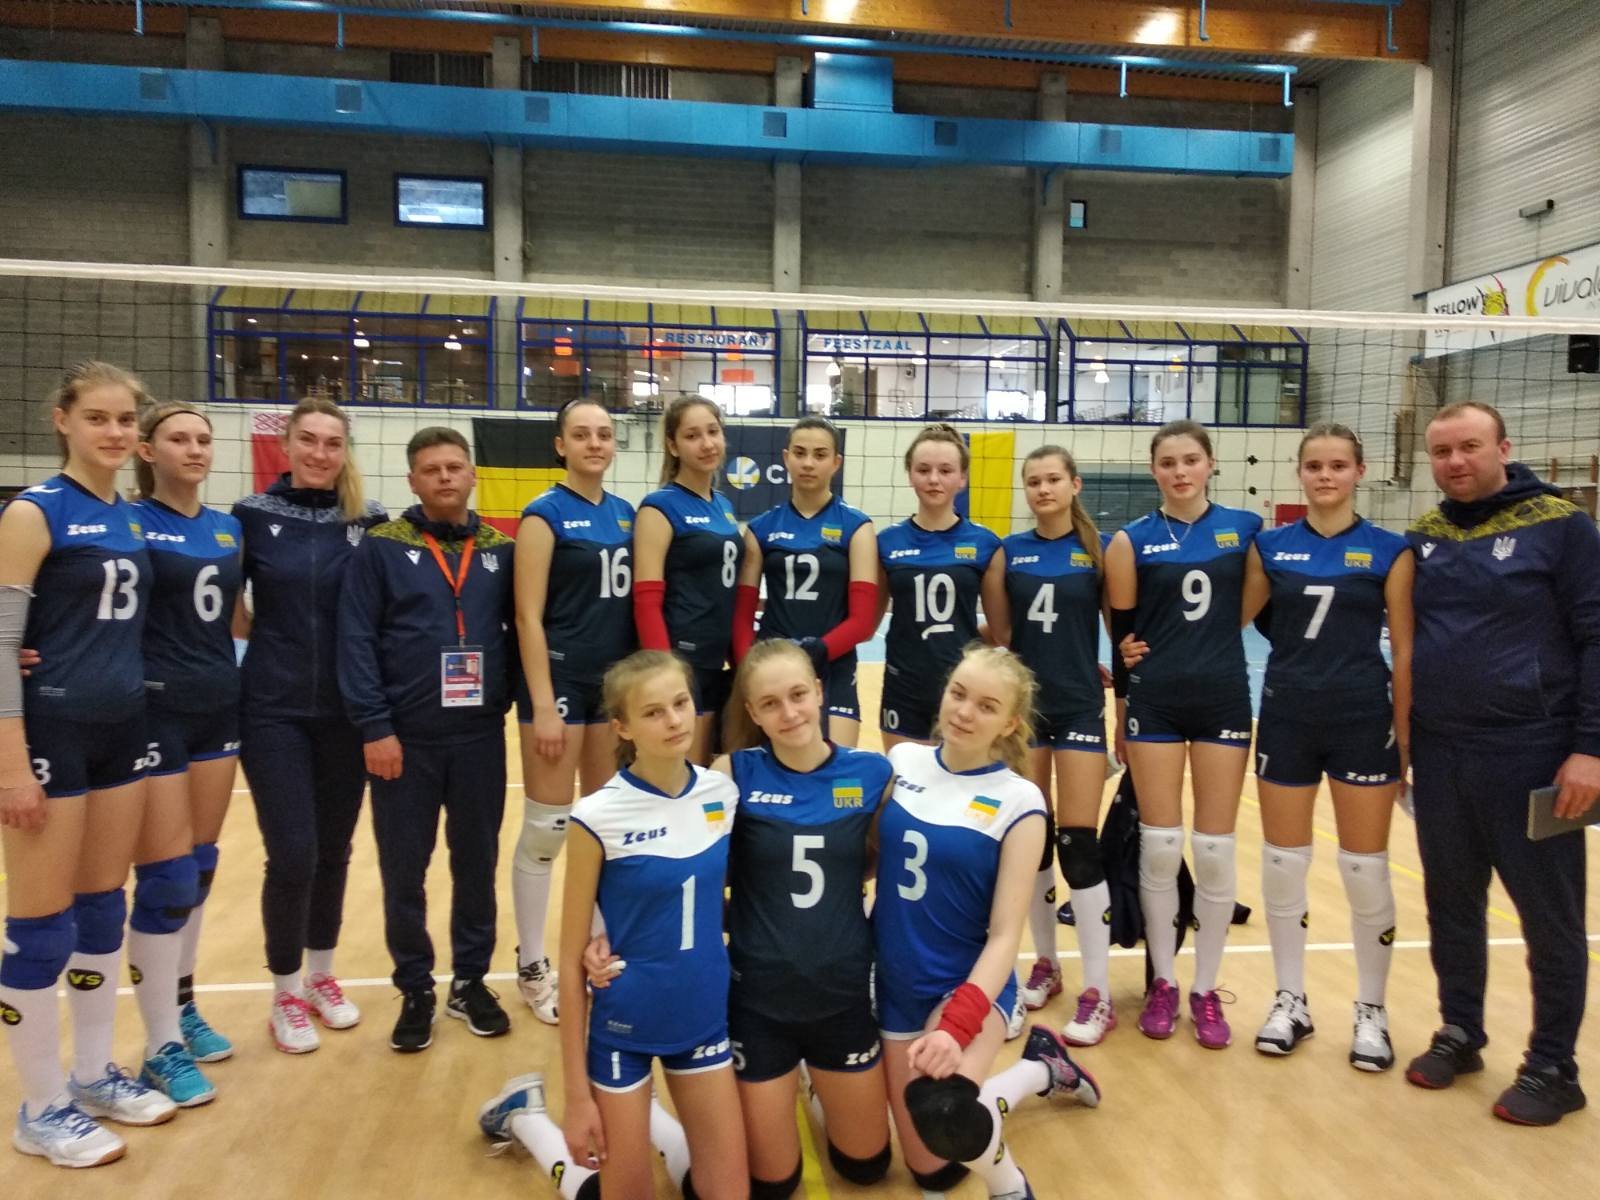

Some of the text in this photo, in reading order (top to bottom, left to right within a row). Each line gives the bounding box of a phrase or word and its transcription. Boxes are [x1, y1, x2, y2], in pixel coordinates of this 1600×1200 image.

[665, 333, 769, 346] RESTAURANT
[824, 338, 912, 350] FEESTZAAL
[67, 523, 107, 536] Zeus
[563, 519, 592, 530] Zeus
[145, 530, 186, 543] Zeus
[768, 532, 794, 541] Zeus
[890, 548, 921, 559] Zeus
[1142, 542, 1180, 554] Zeus
[1273, 552, 1311, 562] Zeus
[721, 540, 738, 588] 8
[1011, 554, 1040, 566] Zeus
[599, 547, 632, 598] 16
[784, 553, 820, 601] 12
[97, 558, 139, 621] 13
[194, 565, 223, 622] 6
[914, 573, 956, 623] 10
[1181, 570, 1212, 622] 9
[1027, 584, 1059, 633] 4
[1303, 585, 1336, 640] 7
[555, 697, 569, 718] 6
[883, 709, 899, 730] 10
[1129, 718, 1139, 737] 9
[1066, 731, 1101, 743] Zeus
[1345, 771, 1388, 782] Zeus
[747, 791, 793, 805] Zeus
[834, 797, 863, 808] UKR
[623, 825, 668, 845] Zeus
[790, 835, 825, 910] 5
[897, 829, 929, 901] 3
[680, 875, 695, 951] 1
[69, 973, 101, 986] VS
[611, 1051, 621, 1080] 1
